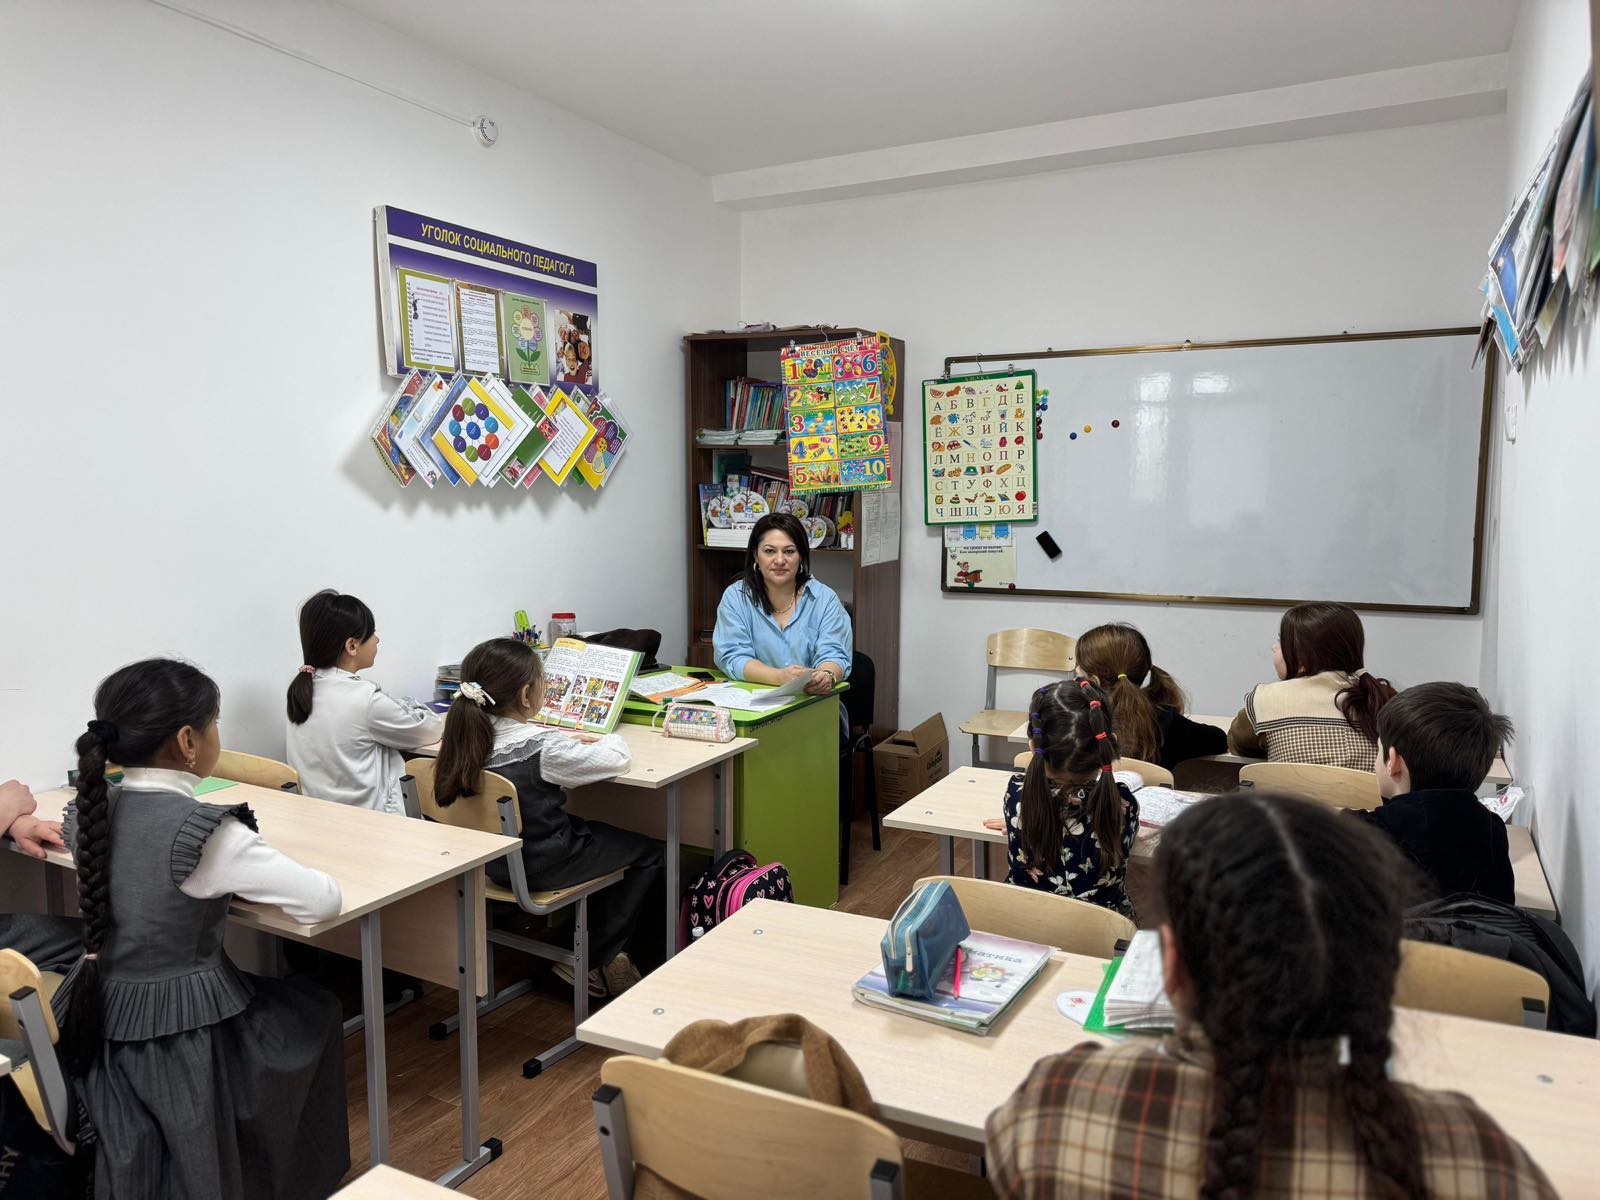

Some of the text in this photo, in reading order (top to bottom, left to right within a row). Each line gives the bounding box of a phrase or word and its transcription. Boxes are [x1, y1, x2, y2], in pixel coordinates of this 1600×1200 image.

[421, 223, 575, 276] УГОЛОК СОЦИАЛЬНОГО ПЕДАГОГА
[790, 363, 799, 379] 1
[862, 354, 876, 371] 6
[789, 389, 803, 406] 2
[866, 382, 877, 399] 7
[934, 394, 1024, 411] А Б В Г Д Е
[791, 416, 804, 432] 3
[867, 408, 880, 425] 8
[935, 421, 1024, 438] Ё Ж З И Й К
[793, 441, 806, 458] 4
[869, 435, 881, 452] 9
[934, 450, 1024, 464] Л М Н О П Р
[795, 467, 807, 483] 5
[864, 460, 884, 475] 10
[935, 477, 1025, 490] С Т У Ф Х Ц
[936, 504, 1024, 518] Ч Ш Щ Э Ю Я
